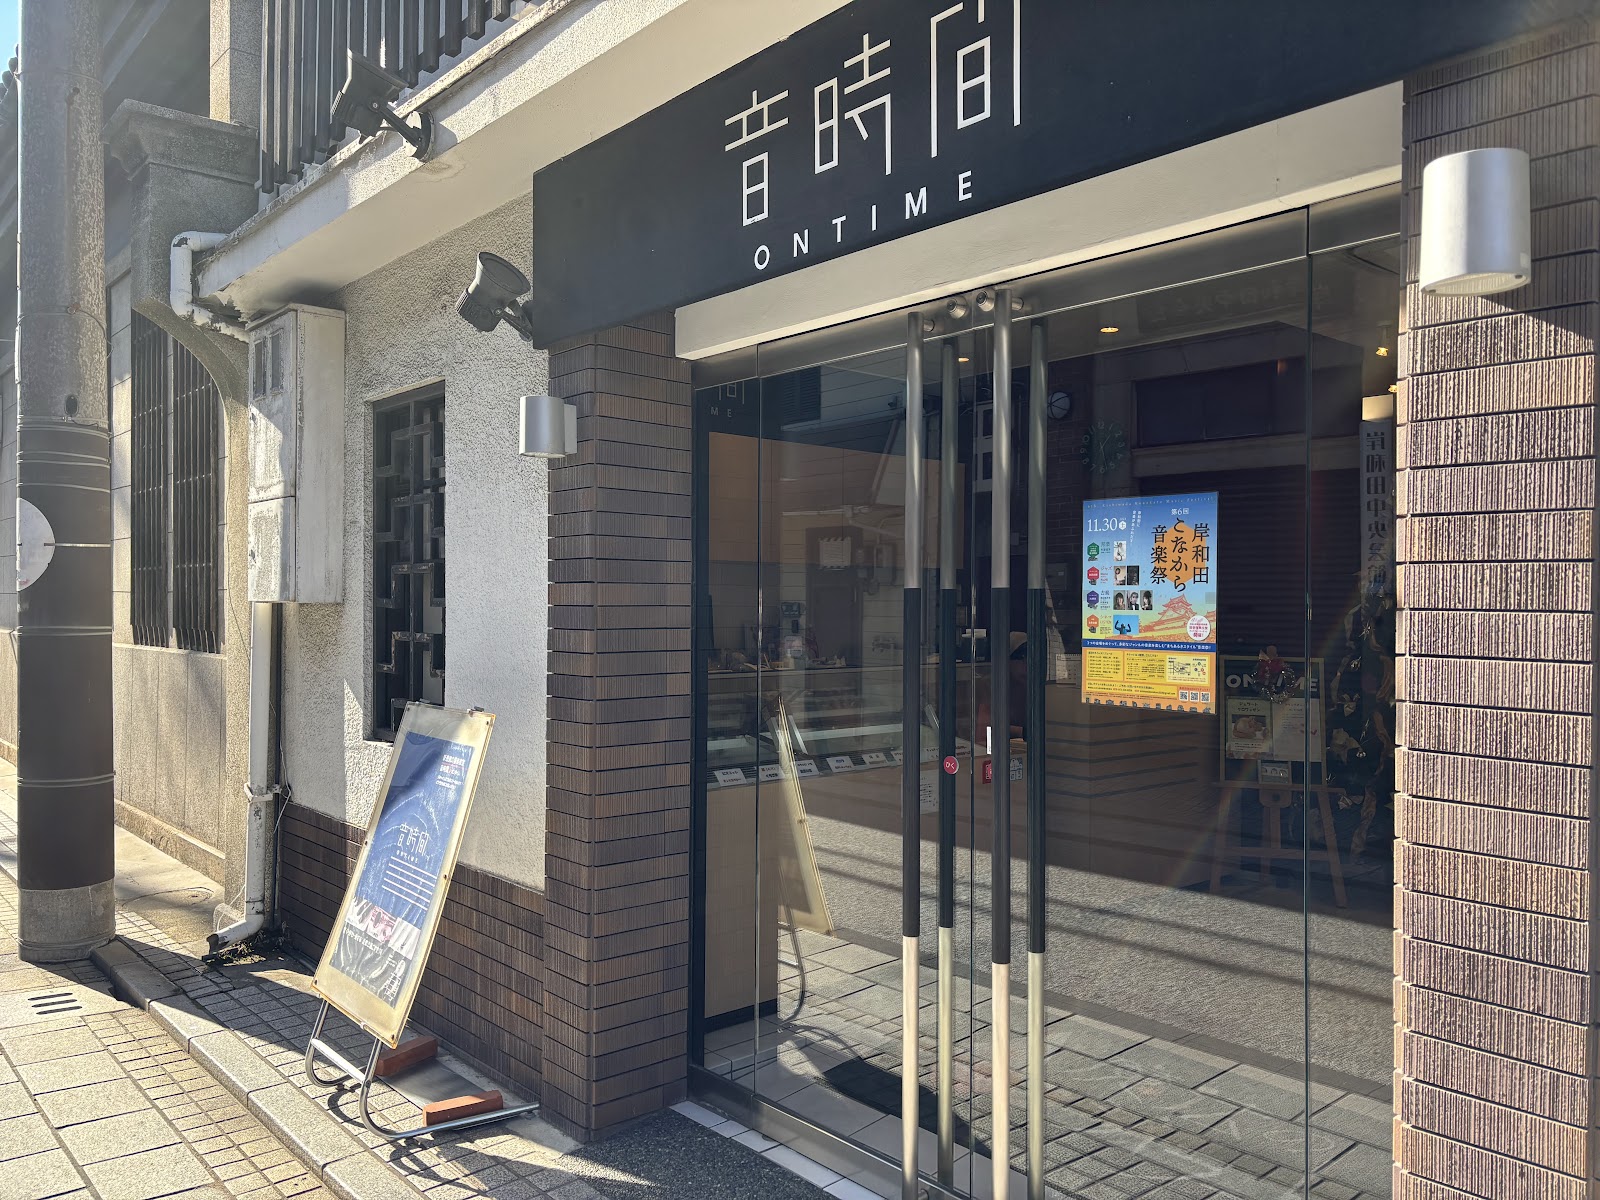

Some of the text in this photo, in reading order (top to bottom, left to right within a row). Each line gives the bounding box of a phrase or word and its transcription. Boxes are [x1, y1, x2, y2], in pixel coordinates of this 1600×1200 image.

[725, 0, 1021, 226] 音時間
[754, 170, 972, 270] ONTIME
[1087, 517, 1118, 532] 11.30
[1171, 507, 1190, 516] 第6回
[1150, 524, 1168, 585] 音楽祭
[1169, 517, 1188, 593] こなから
[1191, 522, 1210, 585] 岸和田
[397, 822, 429, 856] 音時間
